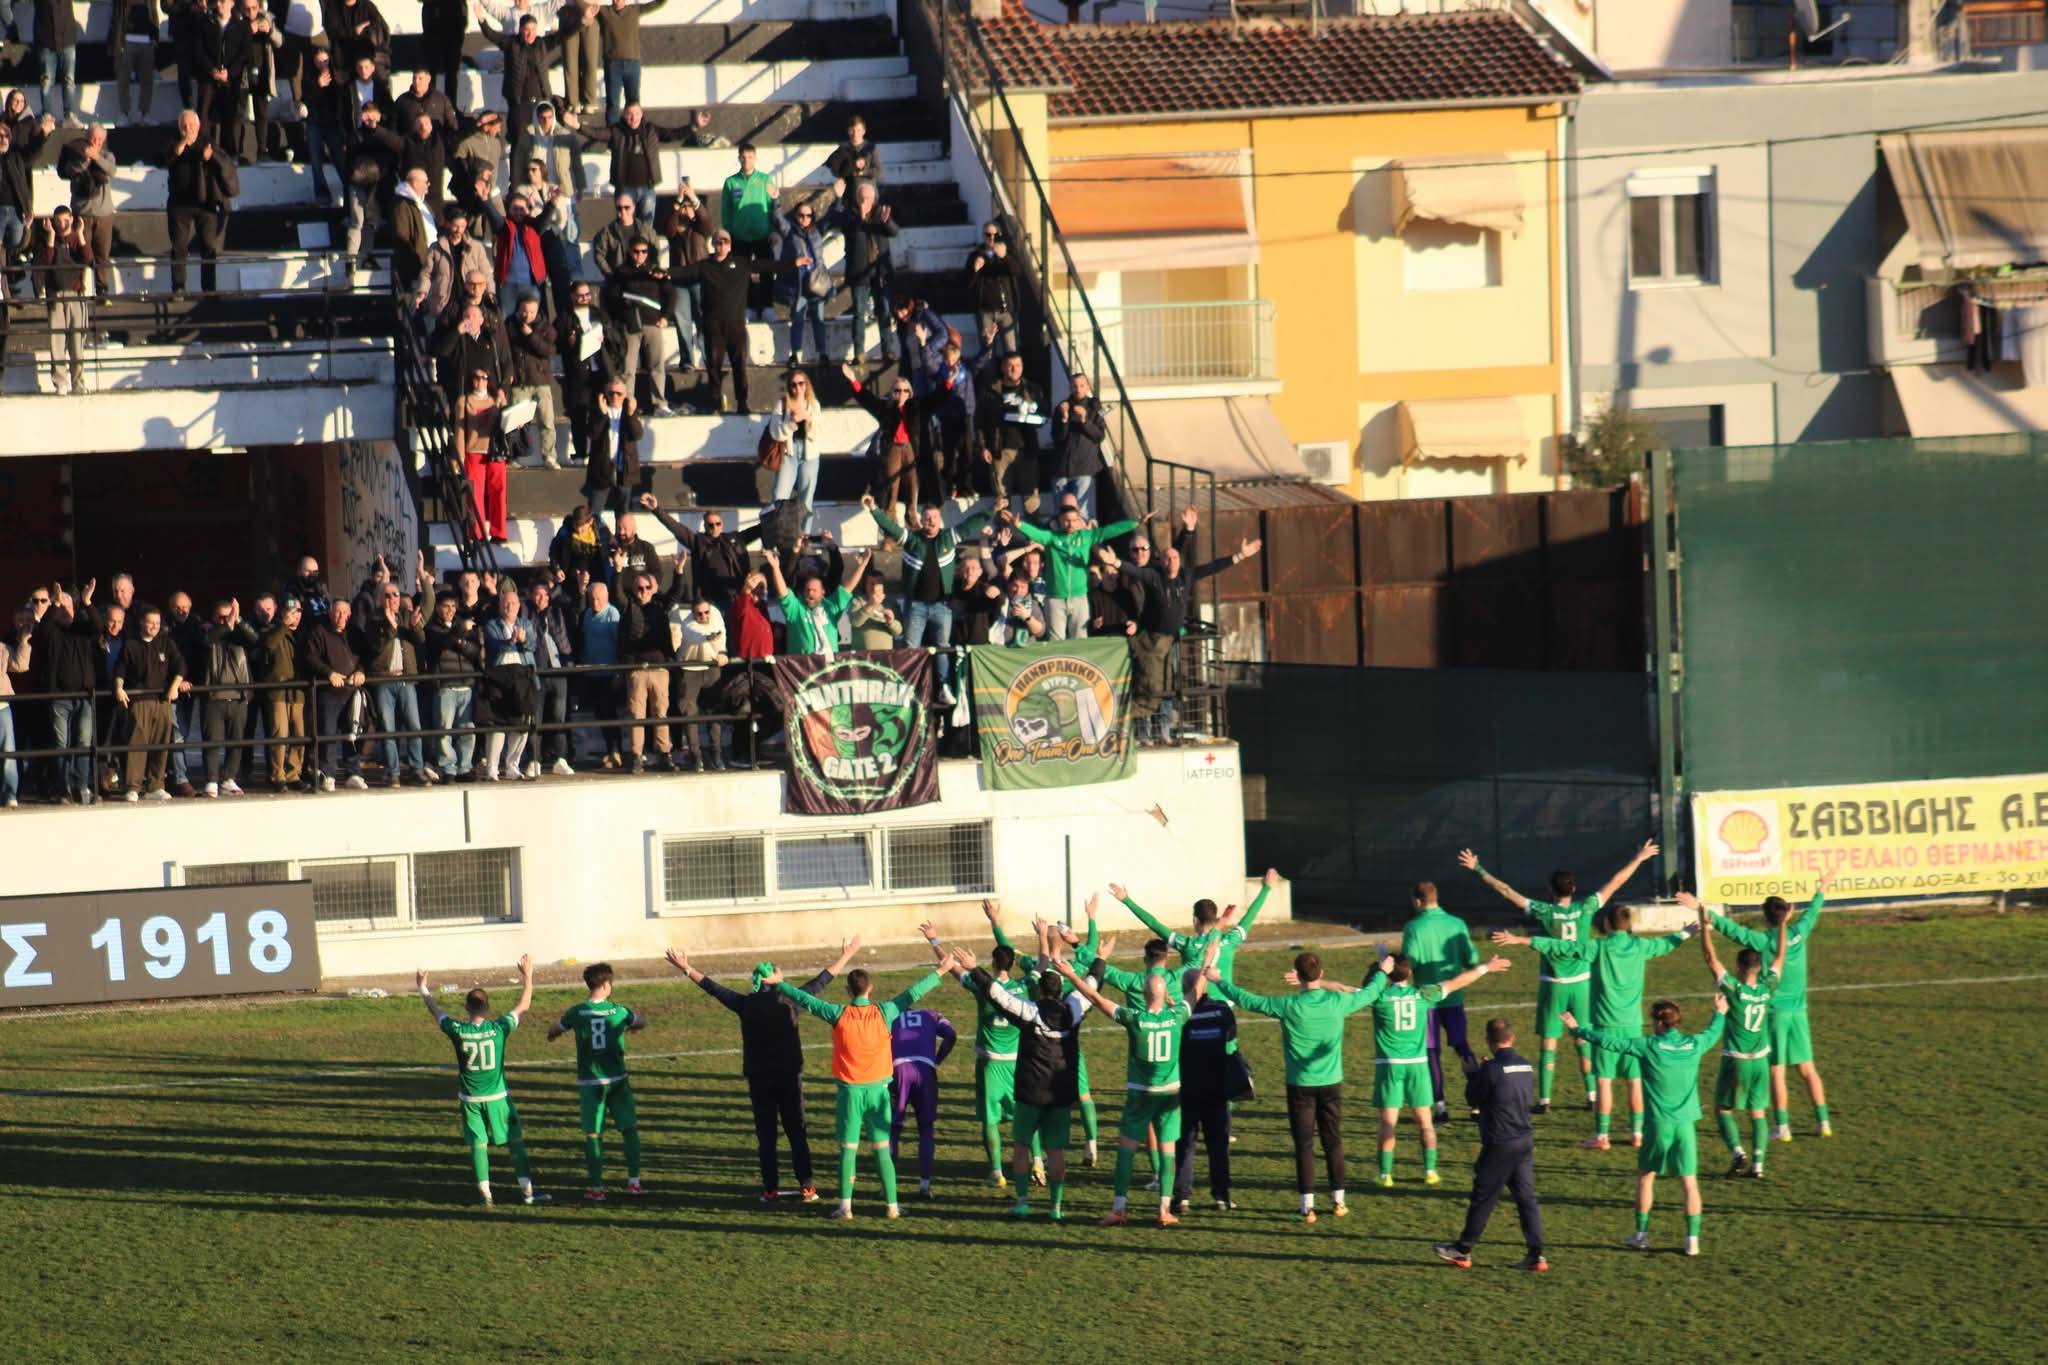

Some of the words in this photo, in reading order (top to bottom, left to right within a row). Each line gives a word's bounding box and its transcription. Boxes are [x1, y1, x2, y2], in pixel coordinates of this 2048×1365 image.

[823, 756, 879, 780] GATE
[877, 752, 897, 774] 2
[1186, 768, 1235, 780] ΙΑΤΡΕΙΟ
[1790, 846, 1918, 872] ΠΕΤΡΕΛΑΙΟ
[1720, 880, 1807, 896] ΟΠΙΣΘΕΝ
[1913, 871, 1979, 887] ΔΟΞΑΣ
[91, 909, 293, 981] 1918
[900, 1009, 922, 1029] 15
[1391, 999, 1417, 1031] 19
[590, 1017, 607, 1050] 8
[1147, 1030, 1171, 1063] 10
[463, 1038, 496, 1071] 20
